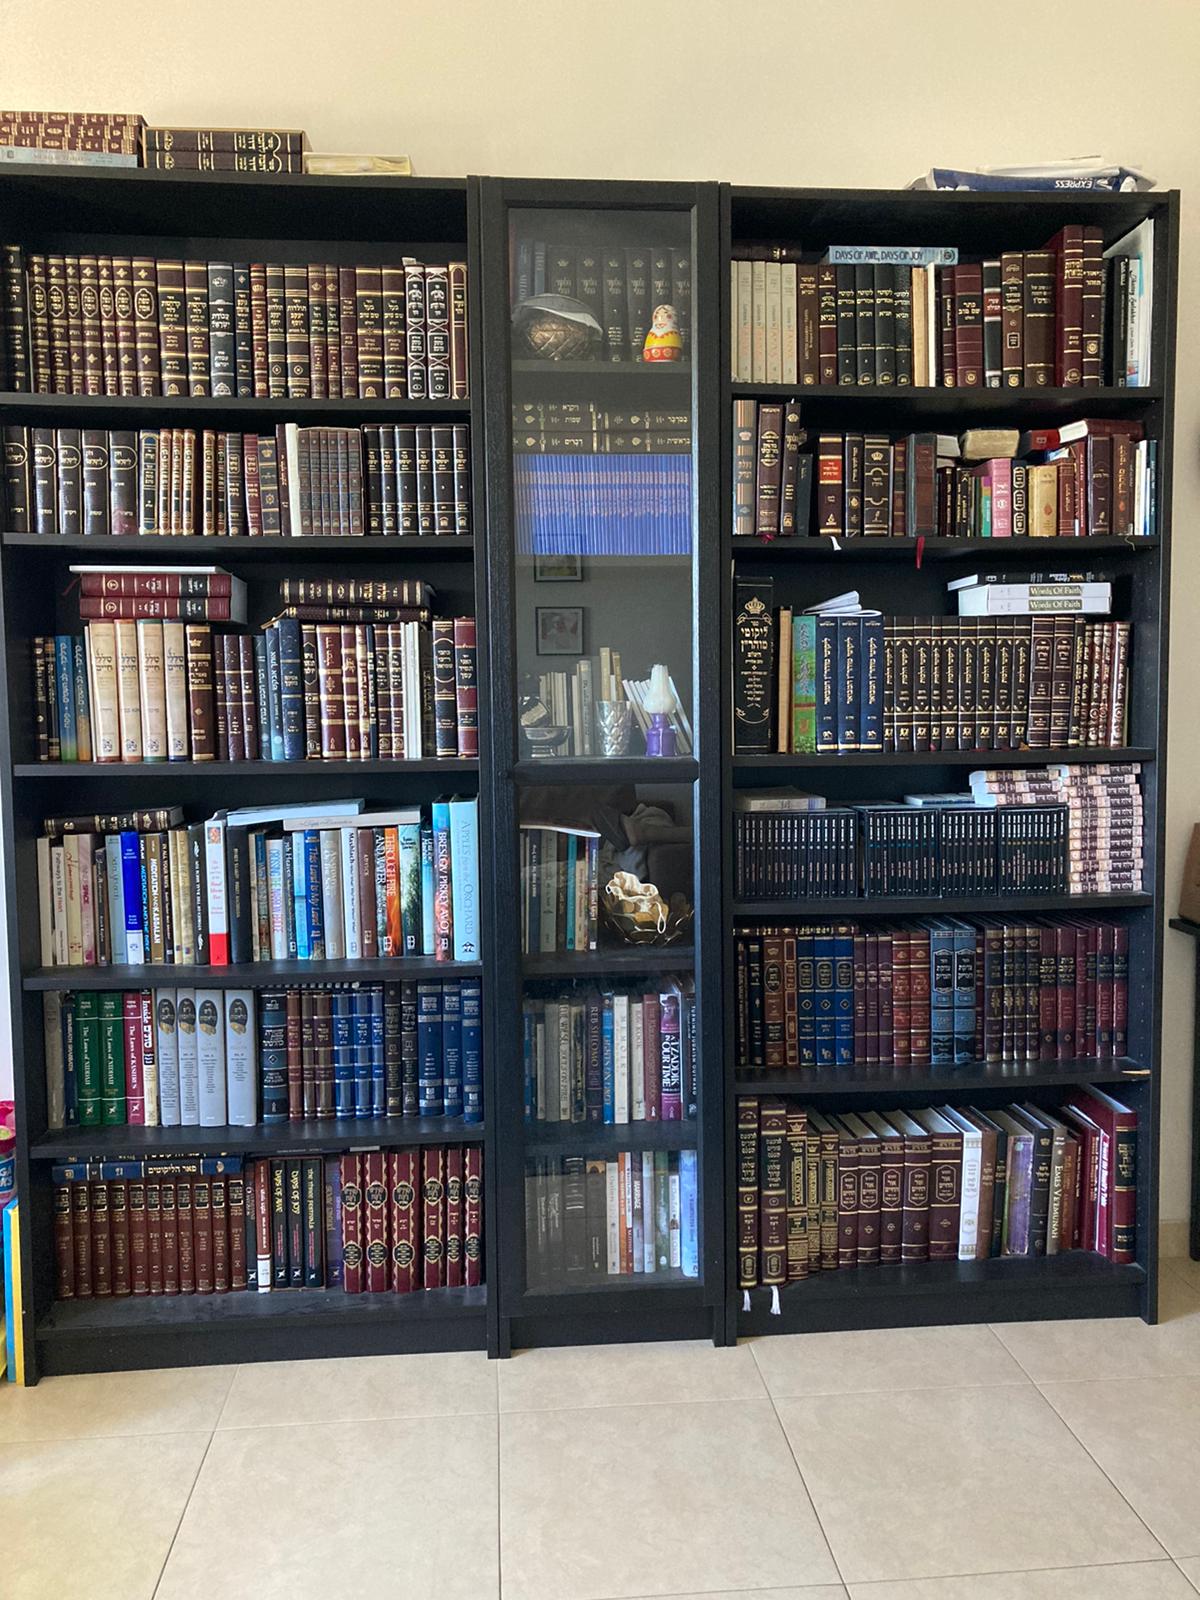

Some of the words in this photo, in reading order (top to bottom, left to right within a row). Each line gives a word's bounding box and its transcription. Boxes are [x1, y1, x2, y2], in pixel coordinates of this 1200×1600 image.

[1055, 180, 1092, 188] EXPRESS
[835, 251, 852, 260] DAYS
[854, 251, 864, 260] OF
[864, 251, 879, 261] AWE,
[881, 251, 898, 260] DAYS
[899, 251, 908, 260] OF
[909, 251, 924, 260] JOY
[1030, 587, 1052, 595] Words
[741, 626, 768, 639] ליקוטי
[822, 637, 831, 657] ליקוטי
[845, 637, 853, 657] ליקוטי
[868, 637, 877, 657] ליקוטי
[822, 680, 831, 704] המבואר
[845, 680, 853, 704] המבואר
[868, 680, 877, 704] המבואר
[376, 835, 384, 854] AND
[462, 820, 472, 855] APPLES
[309, 847, 318, 863] This
[386, 835, 395, 876] THROUGH
[439, 832, 448, 872] BRESLOV
[269, 849, 281, 876] CROSSING
[377, 855, 386, 884] WATER
[271, 876, 281, 888] THE
[310, 865, 320, 883] Land
[387, 879, 396, 896] FIRE
[439, 876, 448, 906] PIRKEY
[272, 888, 282, 913] NARROW
[308, 893, 320, 906] My
[464, 884, 472, 935] ORCHARD
[311, 907, 321, 926] Land
[440, 909, 449, 934] AVOT
[648, 1019, 656, 1074] Klausenberger
[662, 1042, 670, 1063] OUR
[671, 1041, 679, 1086] TZADDIK
[604, 1069, 612, 1080] ON
[662, 1064, 670, 1087] TIME
[148, 1165, 180, 1174] הליקוטים
[1054, 1165, 1063, 1188] EMES
[275, 1188, 282, 1197] OF
[292, 1190, 299, 1200] OF
[291, 1202, 300, 1214] JOY
